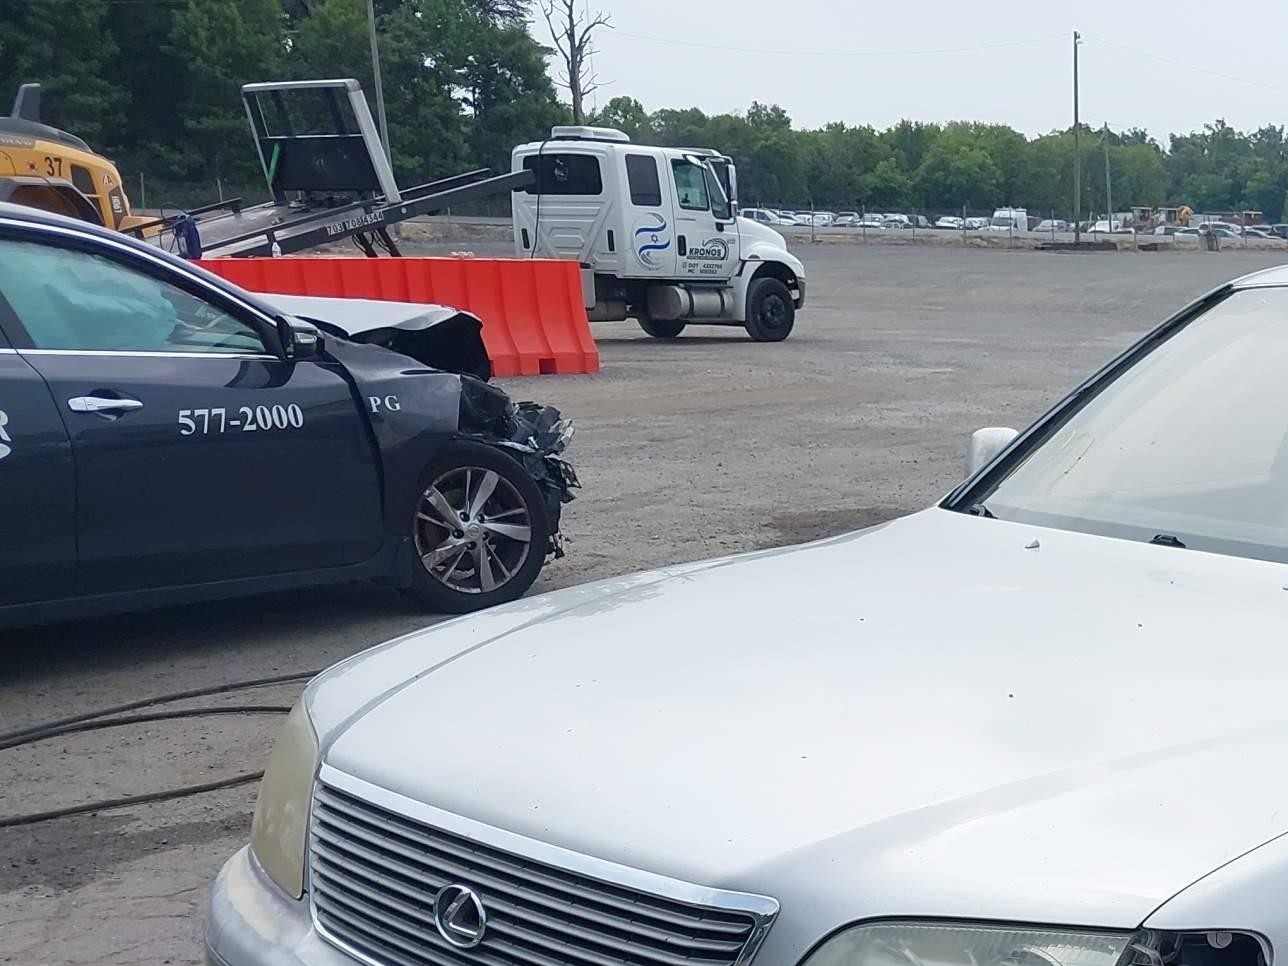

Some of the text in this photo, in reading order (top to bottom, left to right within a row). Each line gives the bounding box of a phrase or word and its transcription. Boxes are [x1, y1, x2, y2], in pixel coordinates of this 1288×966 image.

[45, 156, 63, 176] 37
[326, 223, 345, 235] 703
[689, 248, 721, 256] KRONOS
[369, 395, 401, 413] PG
[177, 404, 304, 436] 577-2000
